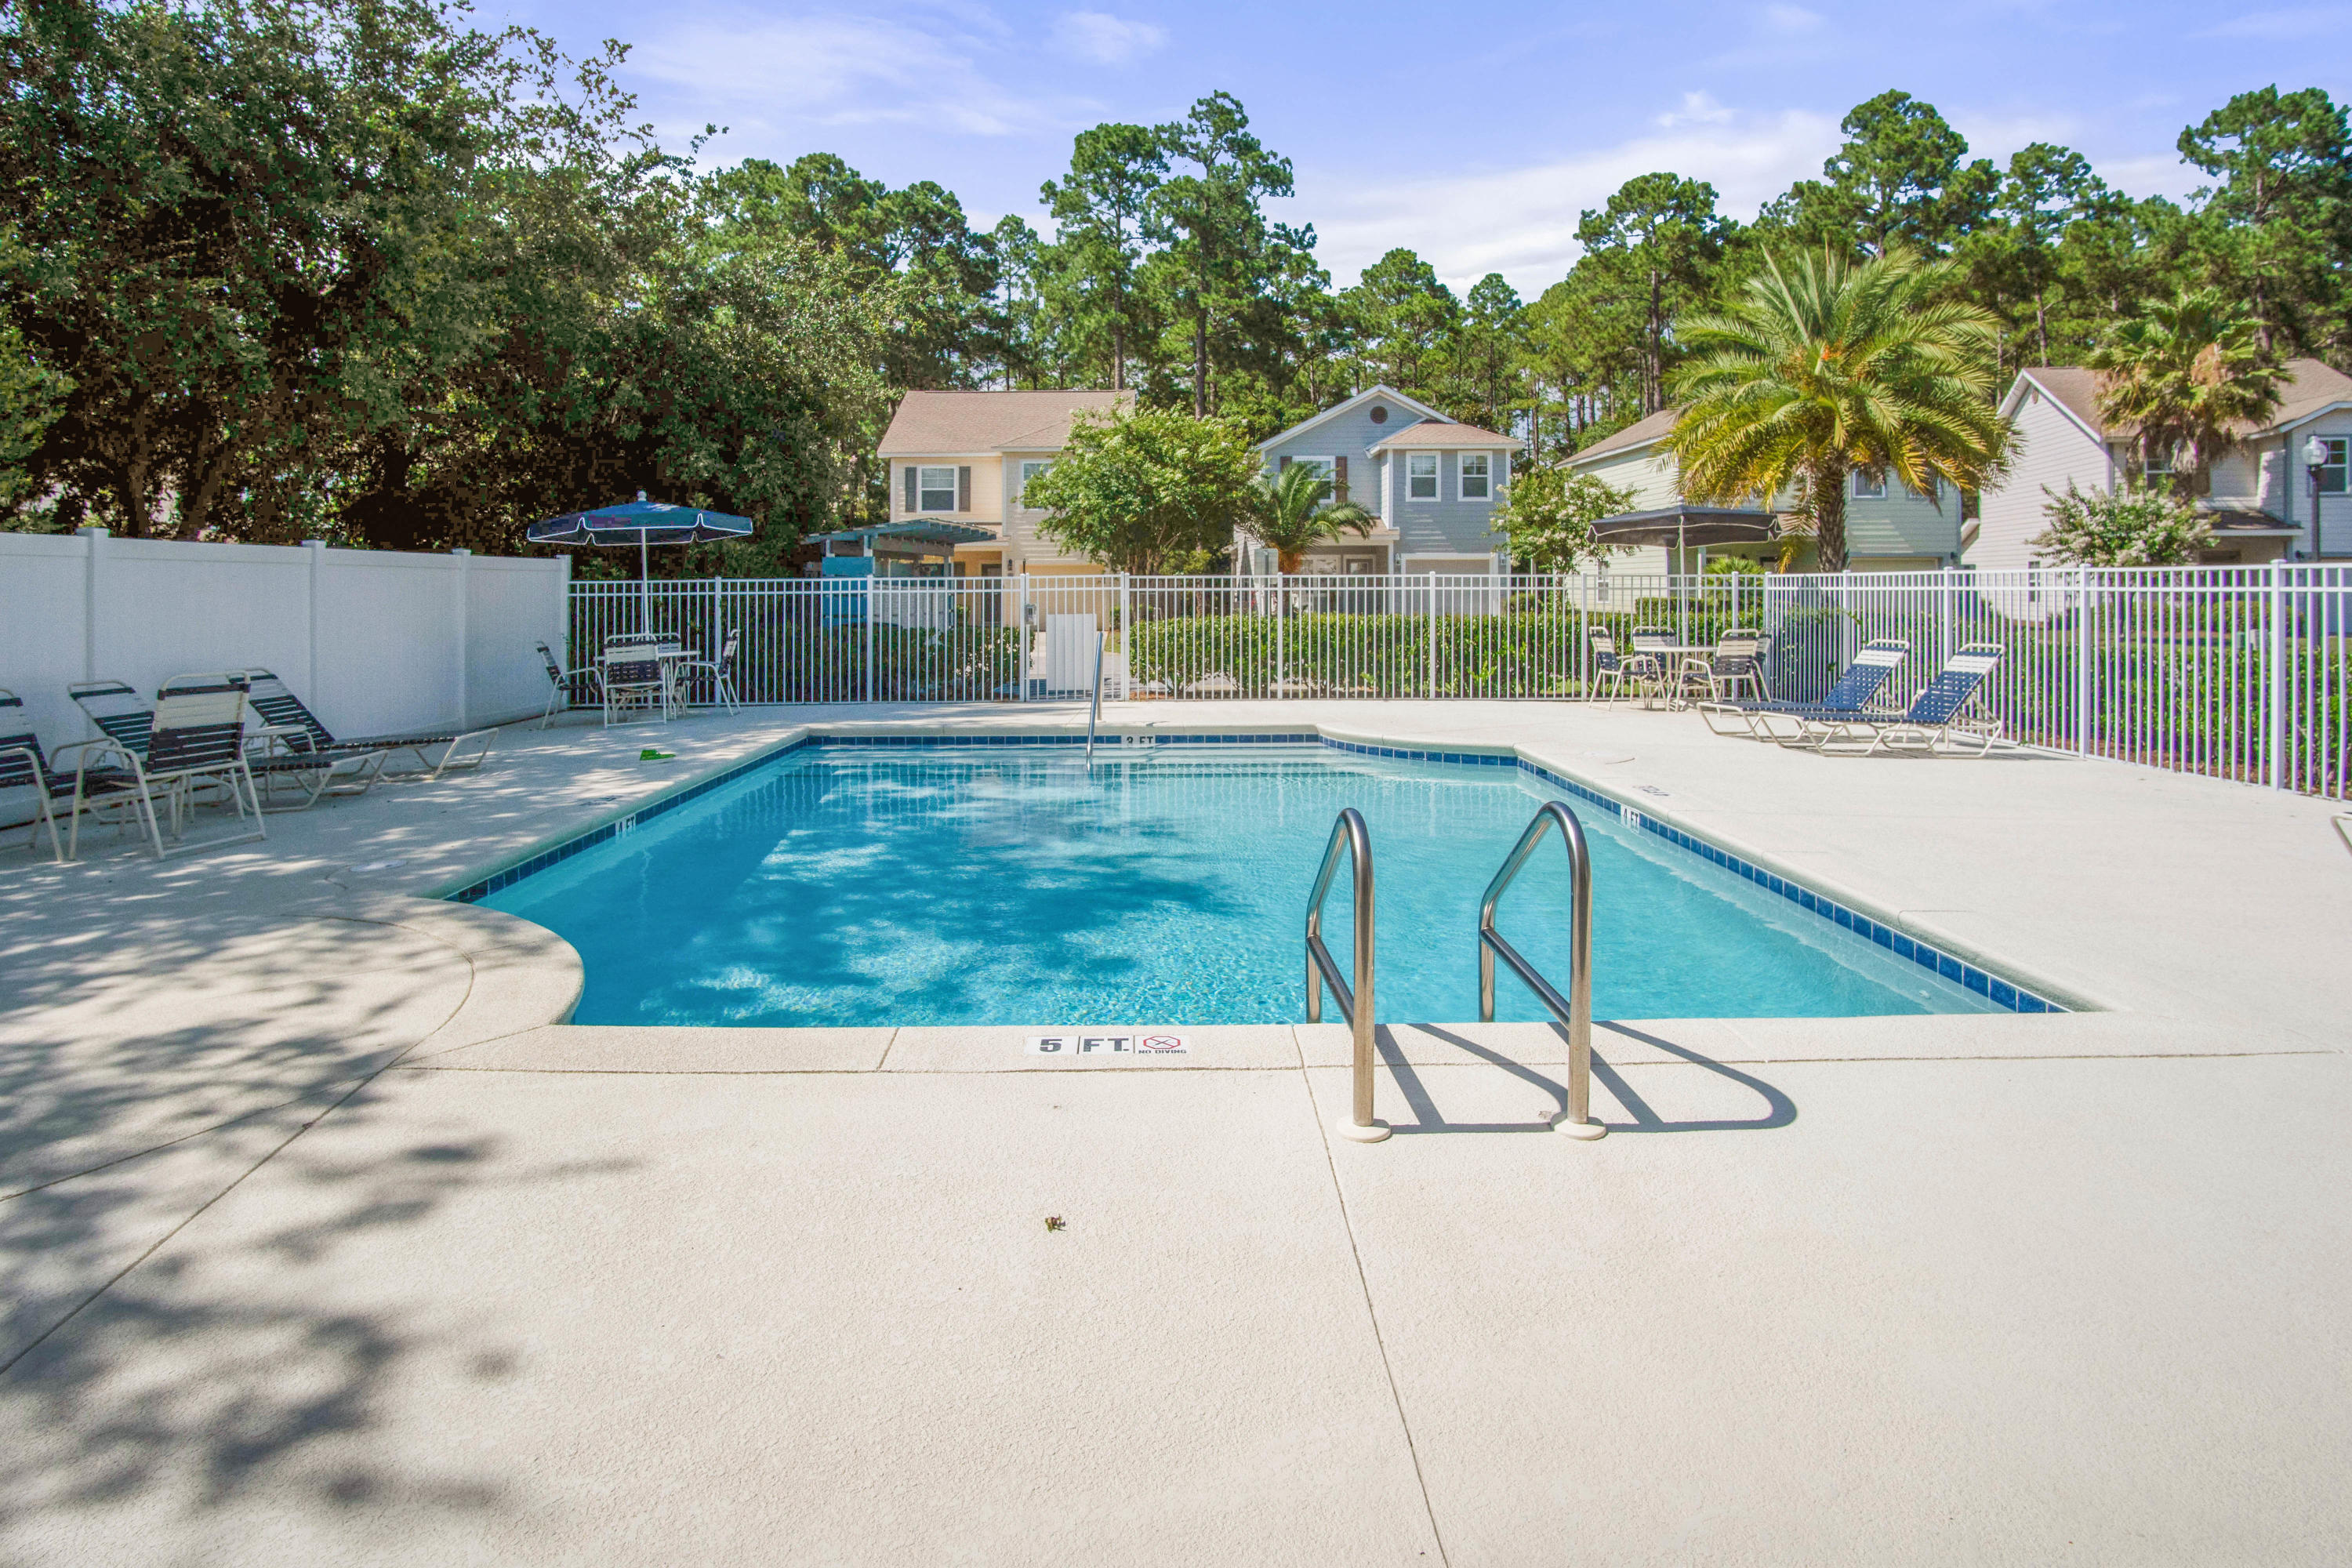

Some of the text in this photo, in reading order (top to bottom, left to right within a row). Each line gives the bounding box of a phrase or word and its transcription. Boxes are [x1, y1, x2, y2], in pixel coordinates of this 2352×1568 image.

[1139, 735, 1153, 744] FT
[1040, 1038, 1130, 1052] 5 FT.
